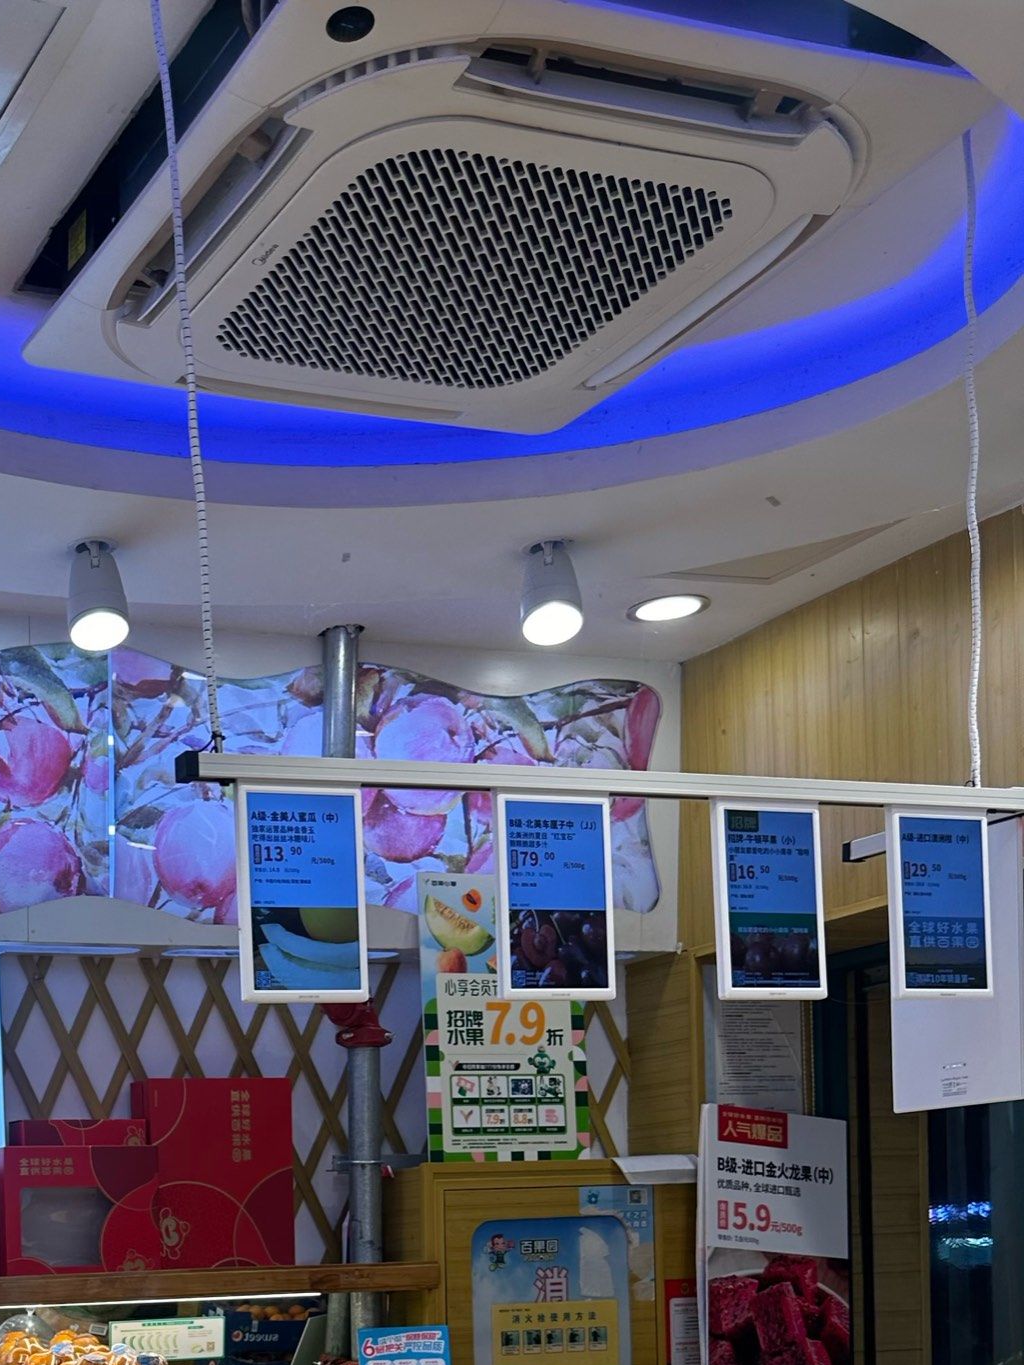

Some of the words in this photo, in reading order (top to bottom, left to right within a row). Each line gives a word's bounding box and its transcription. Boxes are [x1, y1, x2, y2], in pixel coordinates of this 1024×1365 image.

[446, 1009, 484, 1028] 招牌
[485, 1001, 546, 1046] 7.9
[546, 1028, 564, 1047] 折
[447, 1028, 485, 1046] 水果
[722, 1120, 784, 1143] 人气爆品
[732, 1201, 771, 1232] 5.9
